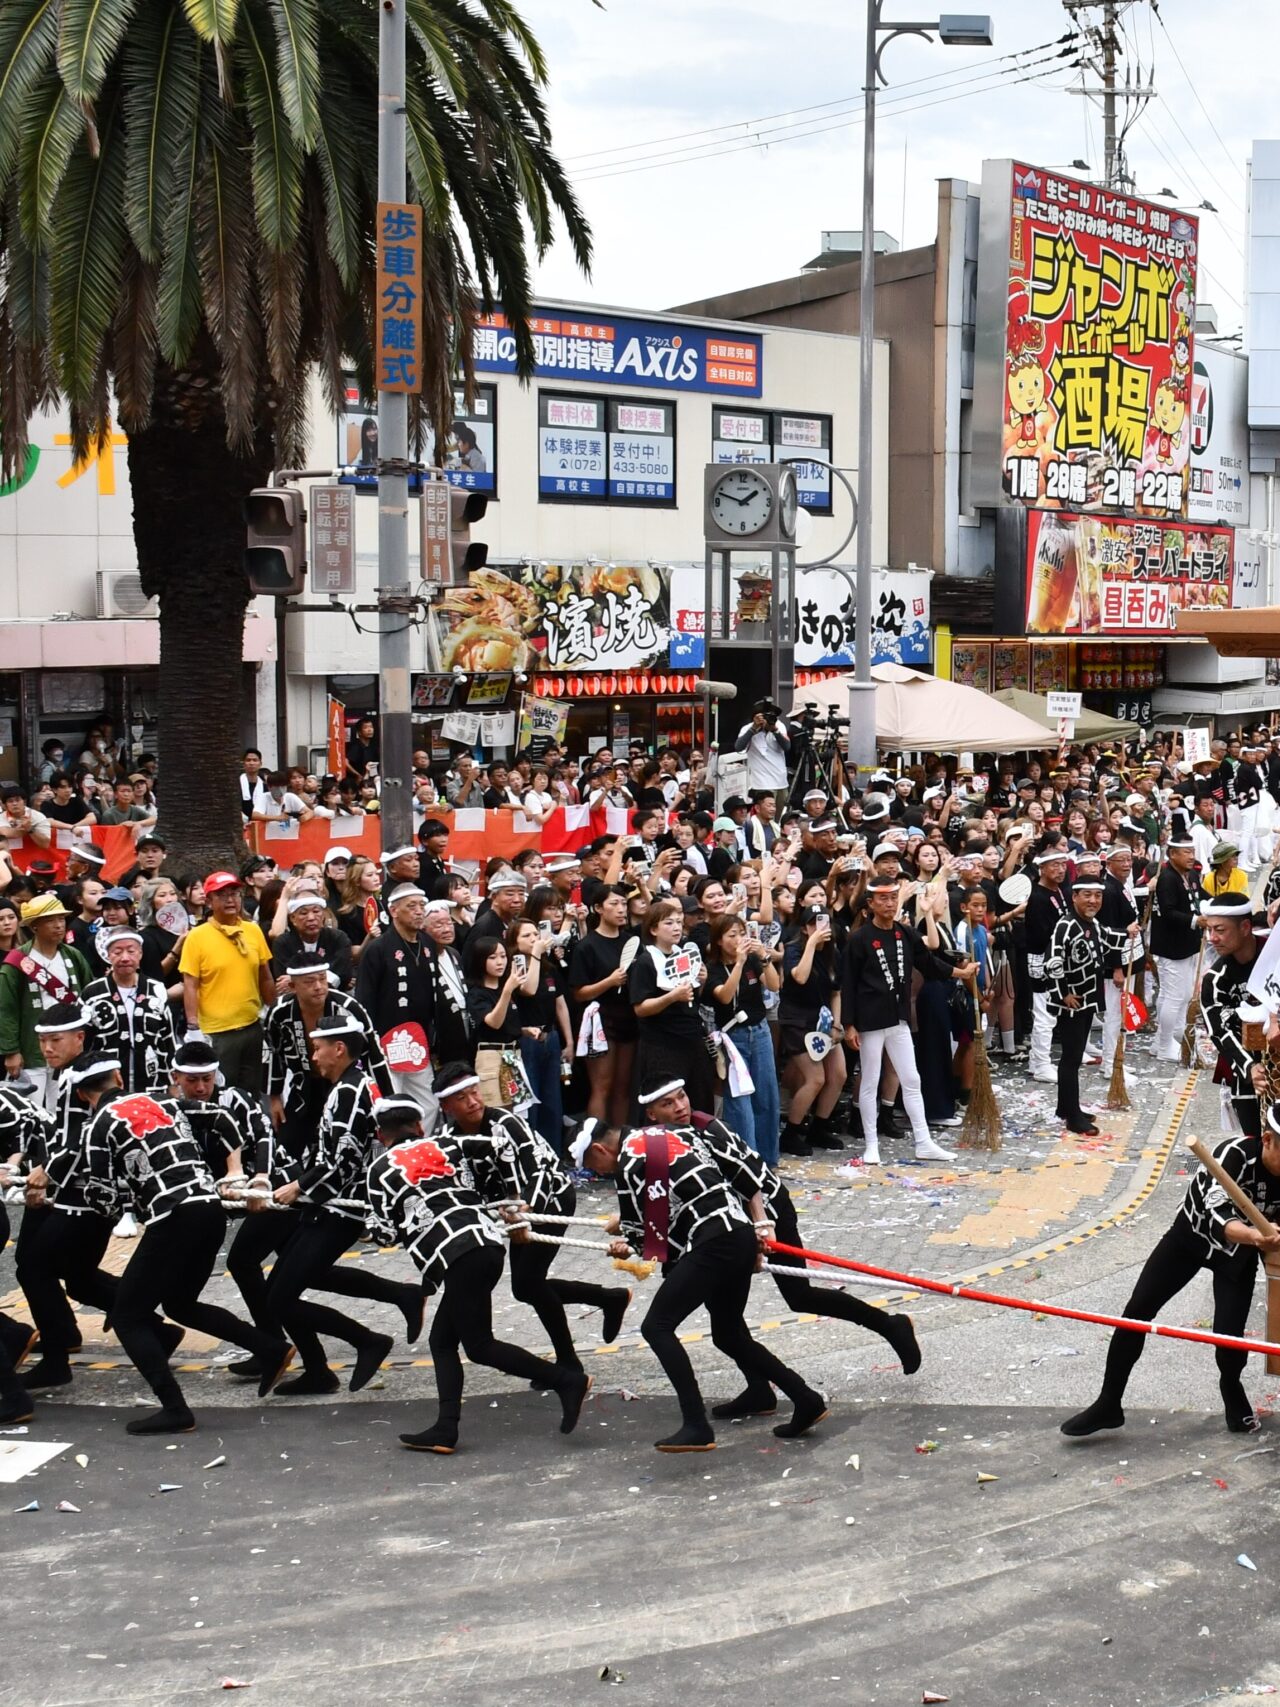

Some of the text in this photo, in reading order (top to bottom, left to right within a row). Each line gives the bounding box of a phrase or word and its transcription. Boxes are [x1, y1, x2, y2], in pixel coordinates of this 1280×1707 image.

[1046, 179, 1090, 209] 生ビール
[1095, 194, 1147, 226] ハイボール
[383, 209, 417, 387] 歩車分離式
[1033, 236, 1177, 340] ジャンボ
[570, 325, 607, 339] 高校生
[645, 335, 671, 348] アクシス
[1063, 320, 1145, 355] ハイボール
[710, 344, 754, 361] 自習席完備
[710, 366, 754, 383] 全科目対応
[550, 403, 662, 430] 無料体 験授業
[1049, 356, 1151, 458] 酒場
[722, 418, 761, 438] 受付中
[544, 436, 661, 461] 体験授業 受付中!
[570, 458, 669, 475] (072) 433-5080
[739, 474, 748, 484] 12
[1218, 471, 1234, 490] 50m
[556, 479, 666, 496] 高校生 自習席完備
[1007, 458, 1183, 511] 1階 28席 2階 22席
[427, 489, 436, 539] 自転車
[436, 489, 448, 541] 歩行者
[714, 497, 772, 508] 9 3
[316, 493, 332, 546] 自転車
[334, 493, 350, 546] 歩行者
[740, 521, 746, 532] 6
[1134, 524, 1162, 545] アサヒ
[432, 544, 442, 580] 専用
[1038, 539, 1065, 572] Asahi
[1101, 538, 1128, 564] 激安
[1133, 546, 1229, 583] スーパードライ
[326, 551, 341, 586] 専用
[1103, 586, 1167, 625] 昼呑み
[543, 586, 657, 664] 濱焼
